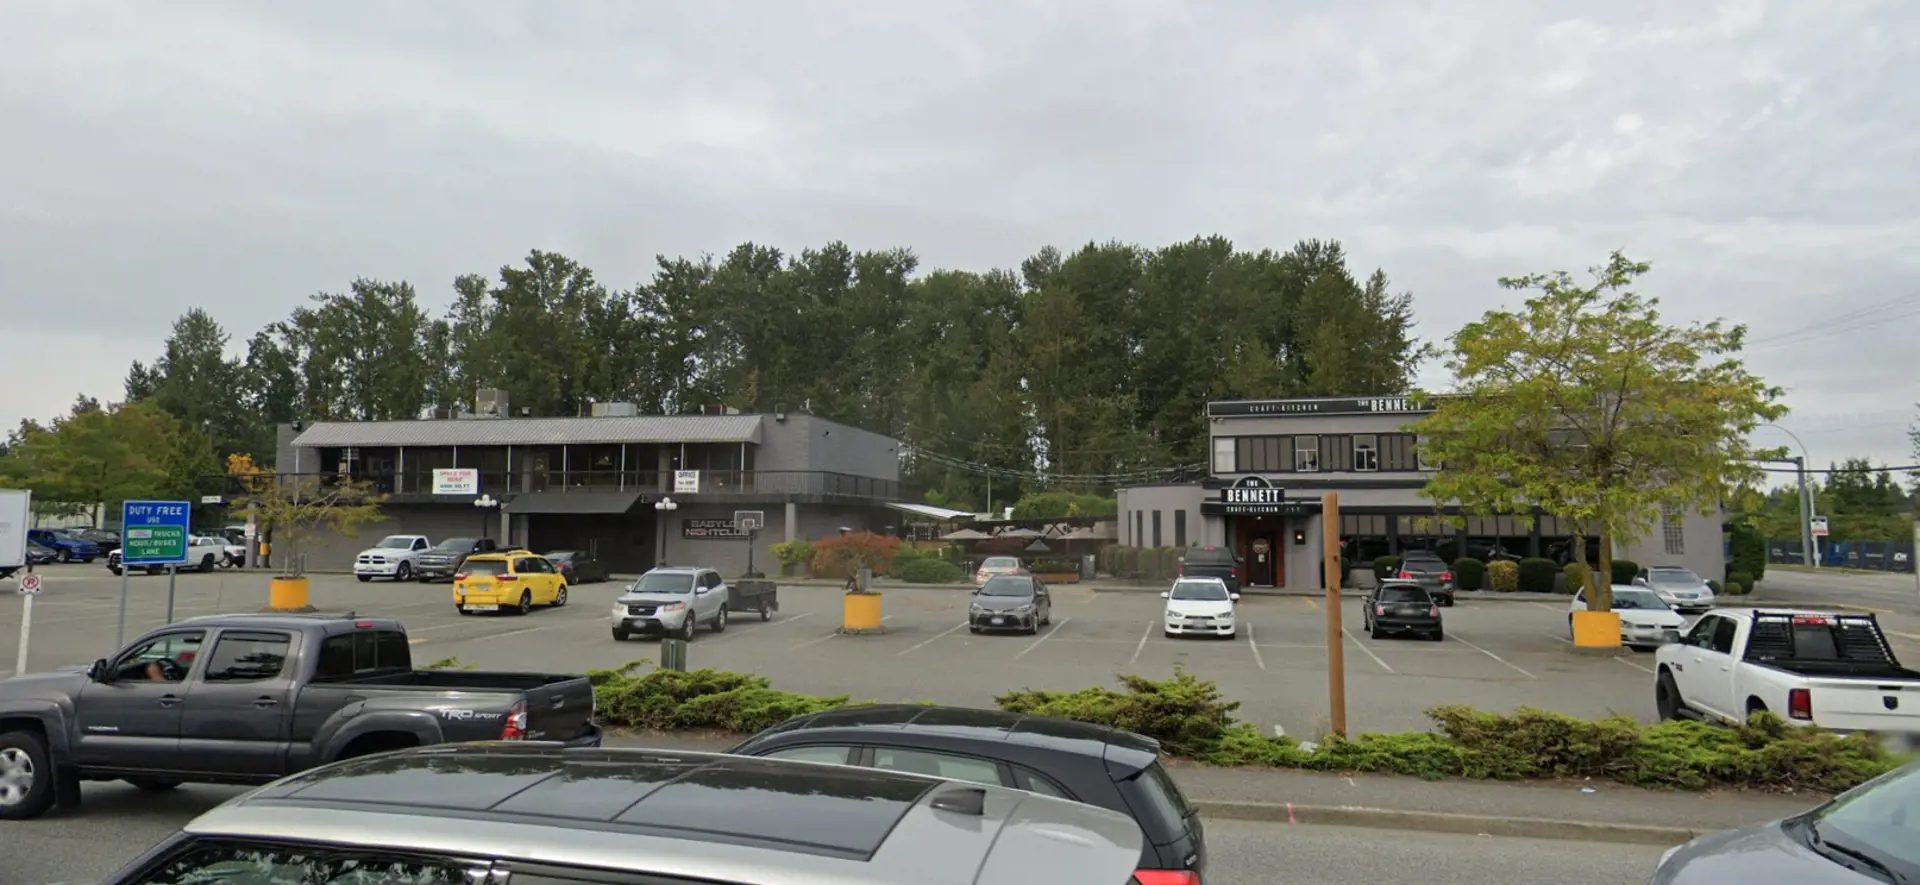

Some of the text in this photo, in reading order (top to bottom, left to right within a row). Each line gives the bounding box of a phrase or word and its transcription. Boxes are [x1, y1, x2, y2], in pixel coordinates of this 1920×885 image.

[1227, 489, 1279, 502] BENNETT
[128, 506, 182, 516] DUTY FREE
[147, 516, 160, 524] USE
[154, 530, 181, 538] TRUCKS
